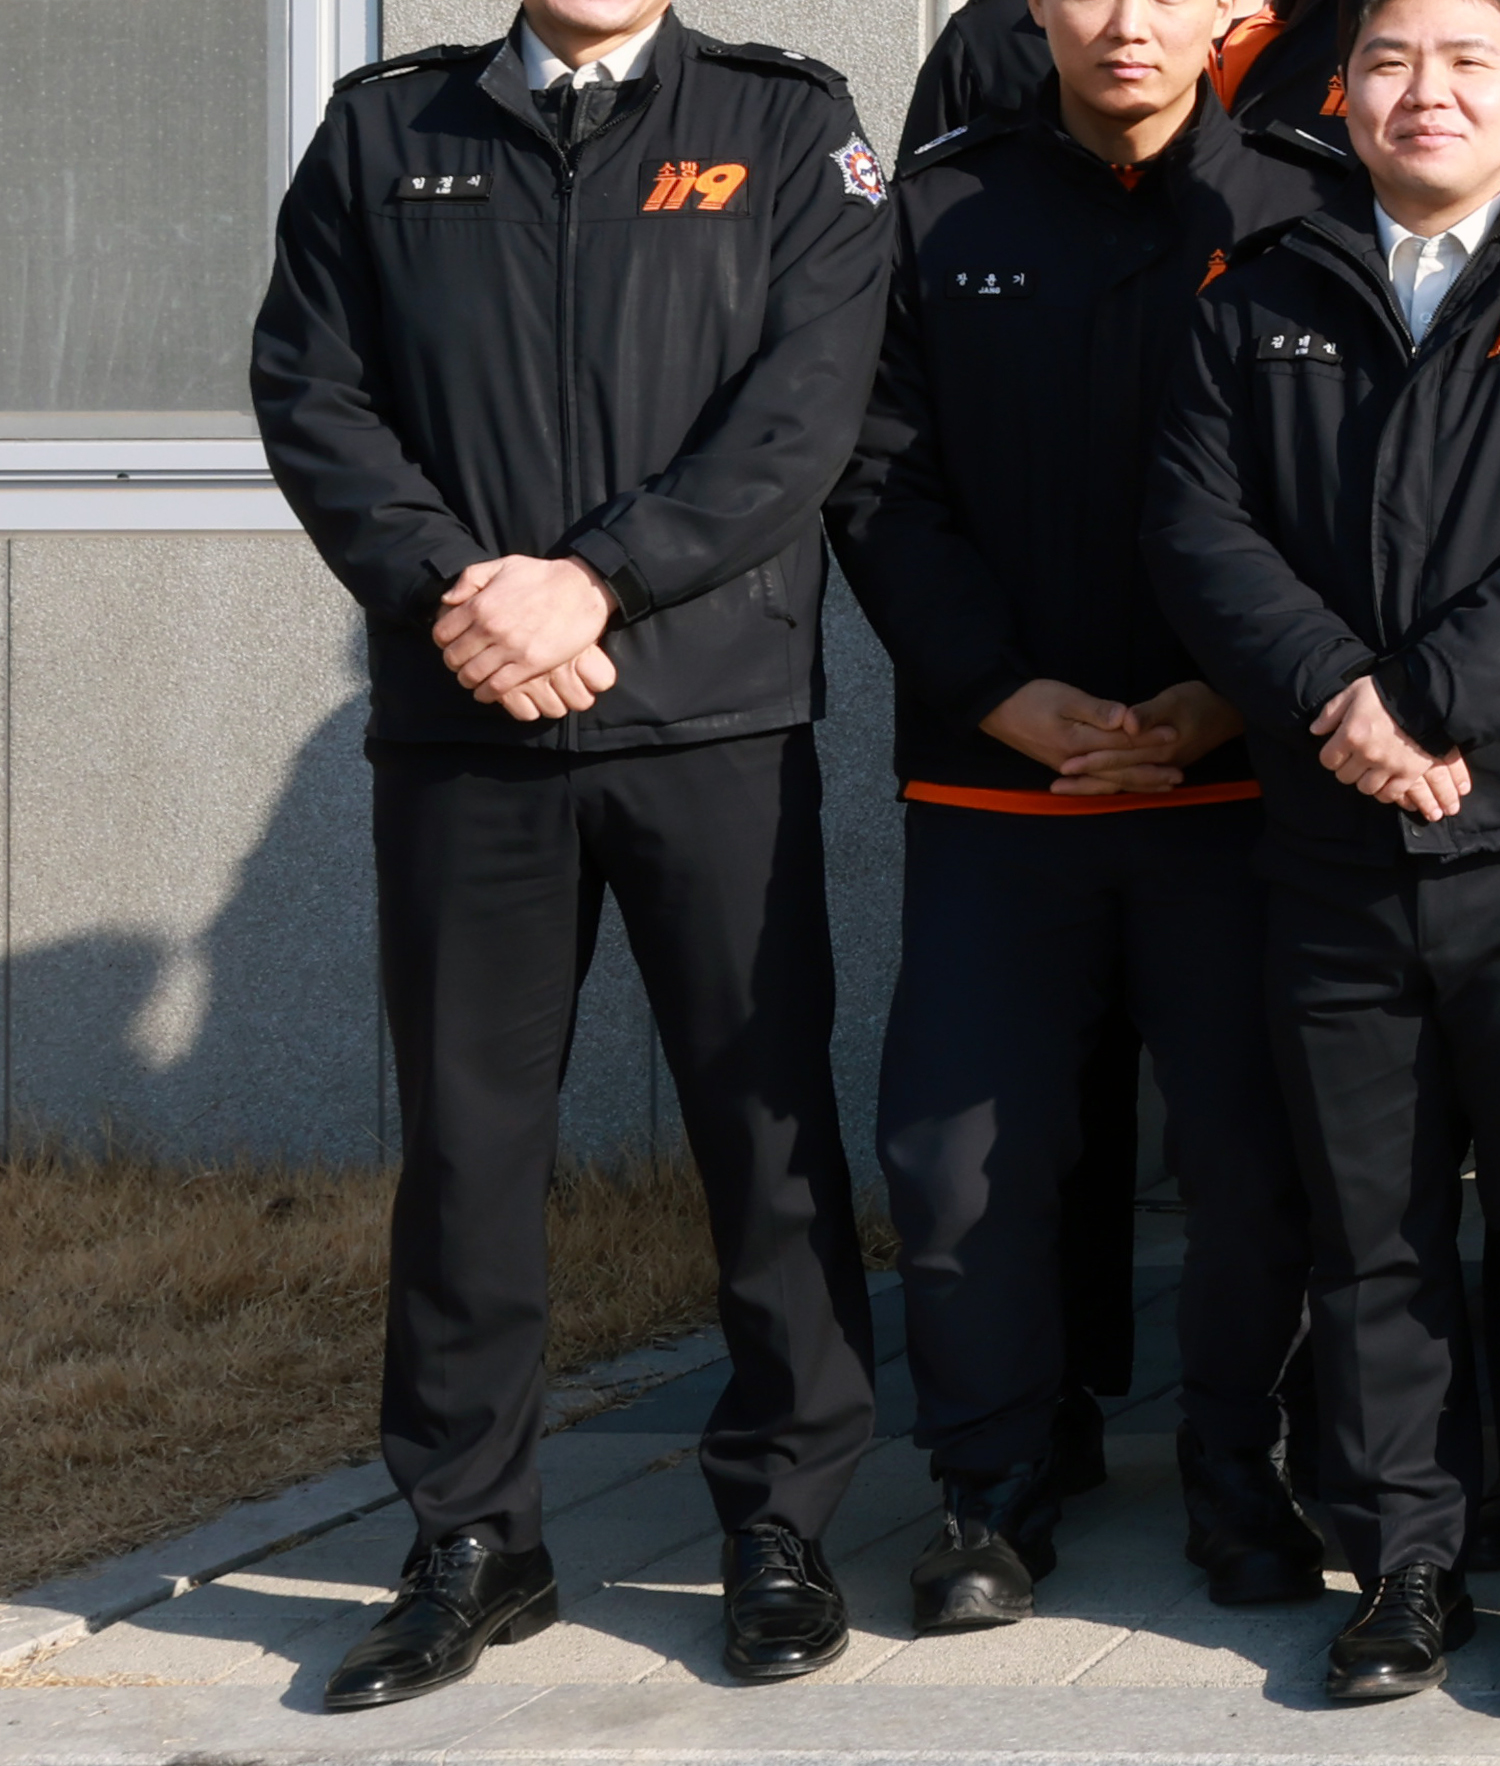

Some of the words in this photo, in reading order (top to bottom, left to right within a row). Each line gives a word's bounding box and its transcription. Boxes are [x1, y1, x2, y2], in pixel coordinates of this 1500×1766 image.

[1319, 89, 1347, 116] 11
[656, 161, 699, 178] 소방
[642, 163, 748, 211] 119
